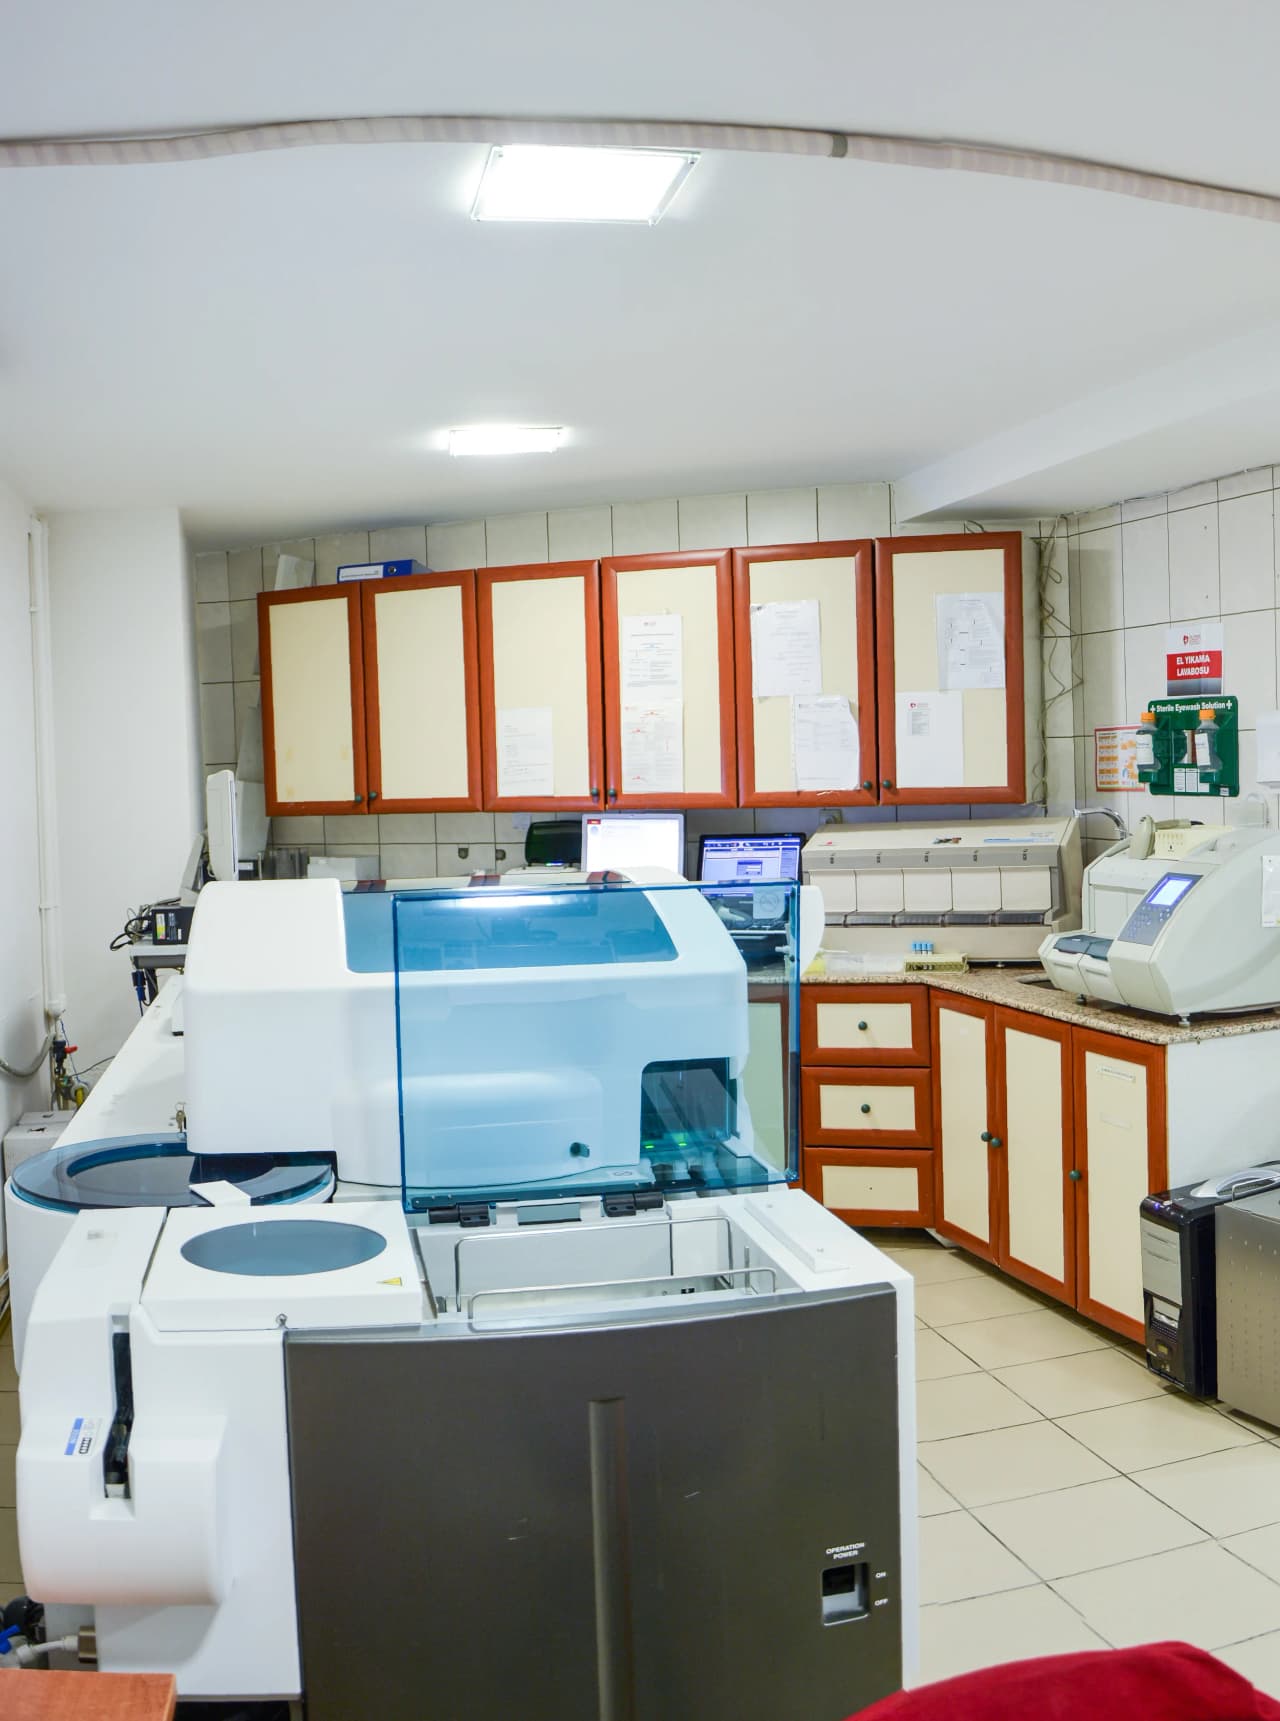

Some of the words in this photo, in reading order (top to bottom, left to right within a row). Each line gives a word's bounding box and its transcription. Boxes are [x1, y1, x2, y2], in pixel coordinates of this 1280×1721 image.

[1176, 656, 1184, 665] EL
[1185, 654, 1211, 664] YIKAMA
[1176, 666, 1210, 676] LAVABOSU
[1156, 704, 1174, 712] Sterile
[1175, 703, 1200, 713] Eyewash
[1201, 701, 1226, 710] Solution
[826, 1542, 865, 1554] OPERATION
[833, 1550, 858, 1559] POWER
[874, 1598, 888, 1606] OFF
